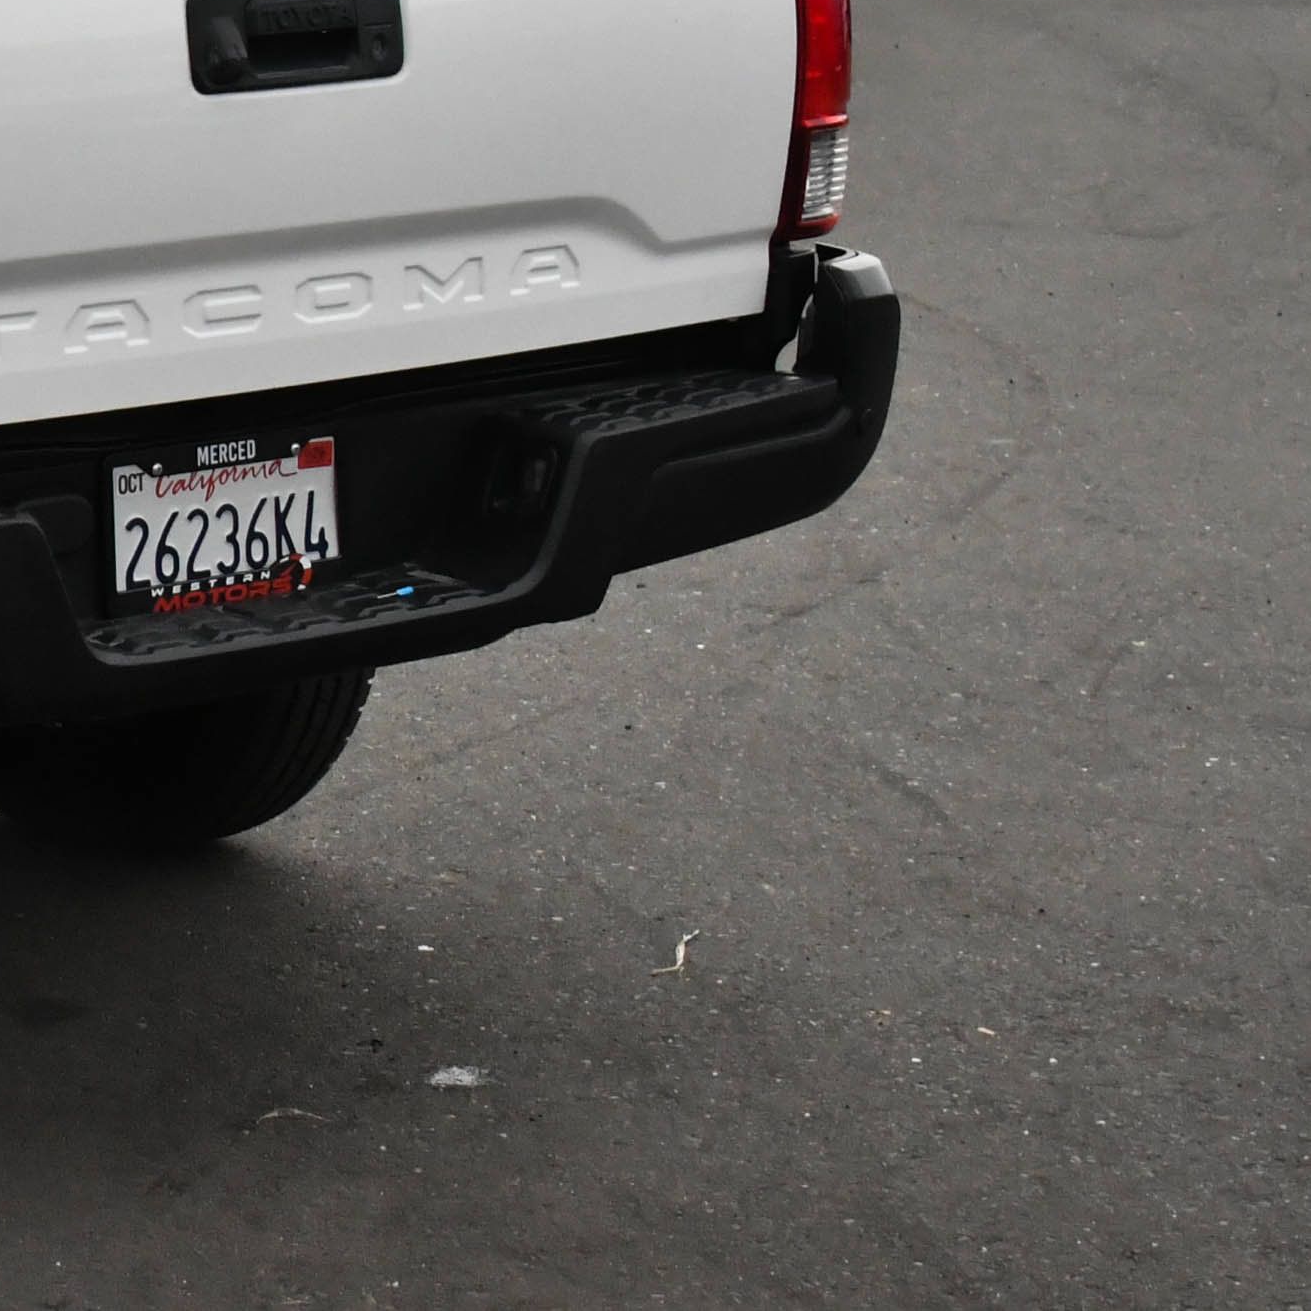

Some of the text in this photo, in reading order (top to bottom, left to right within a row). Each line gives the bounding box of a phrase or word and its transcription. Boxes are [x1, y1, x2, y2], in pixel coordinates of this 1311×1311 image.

[196, 439, 257, 467] MERCED
[118, 459, 298, 502] OCT California
[125, 490, 329, 590] 26236K4
[151, 570, 272, 598] WESTERN
[153, 576, 294, 613] MOTORS
